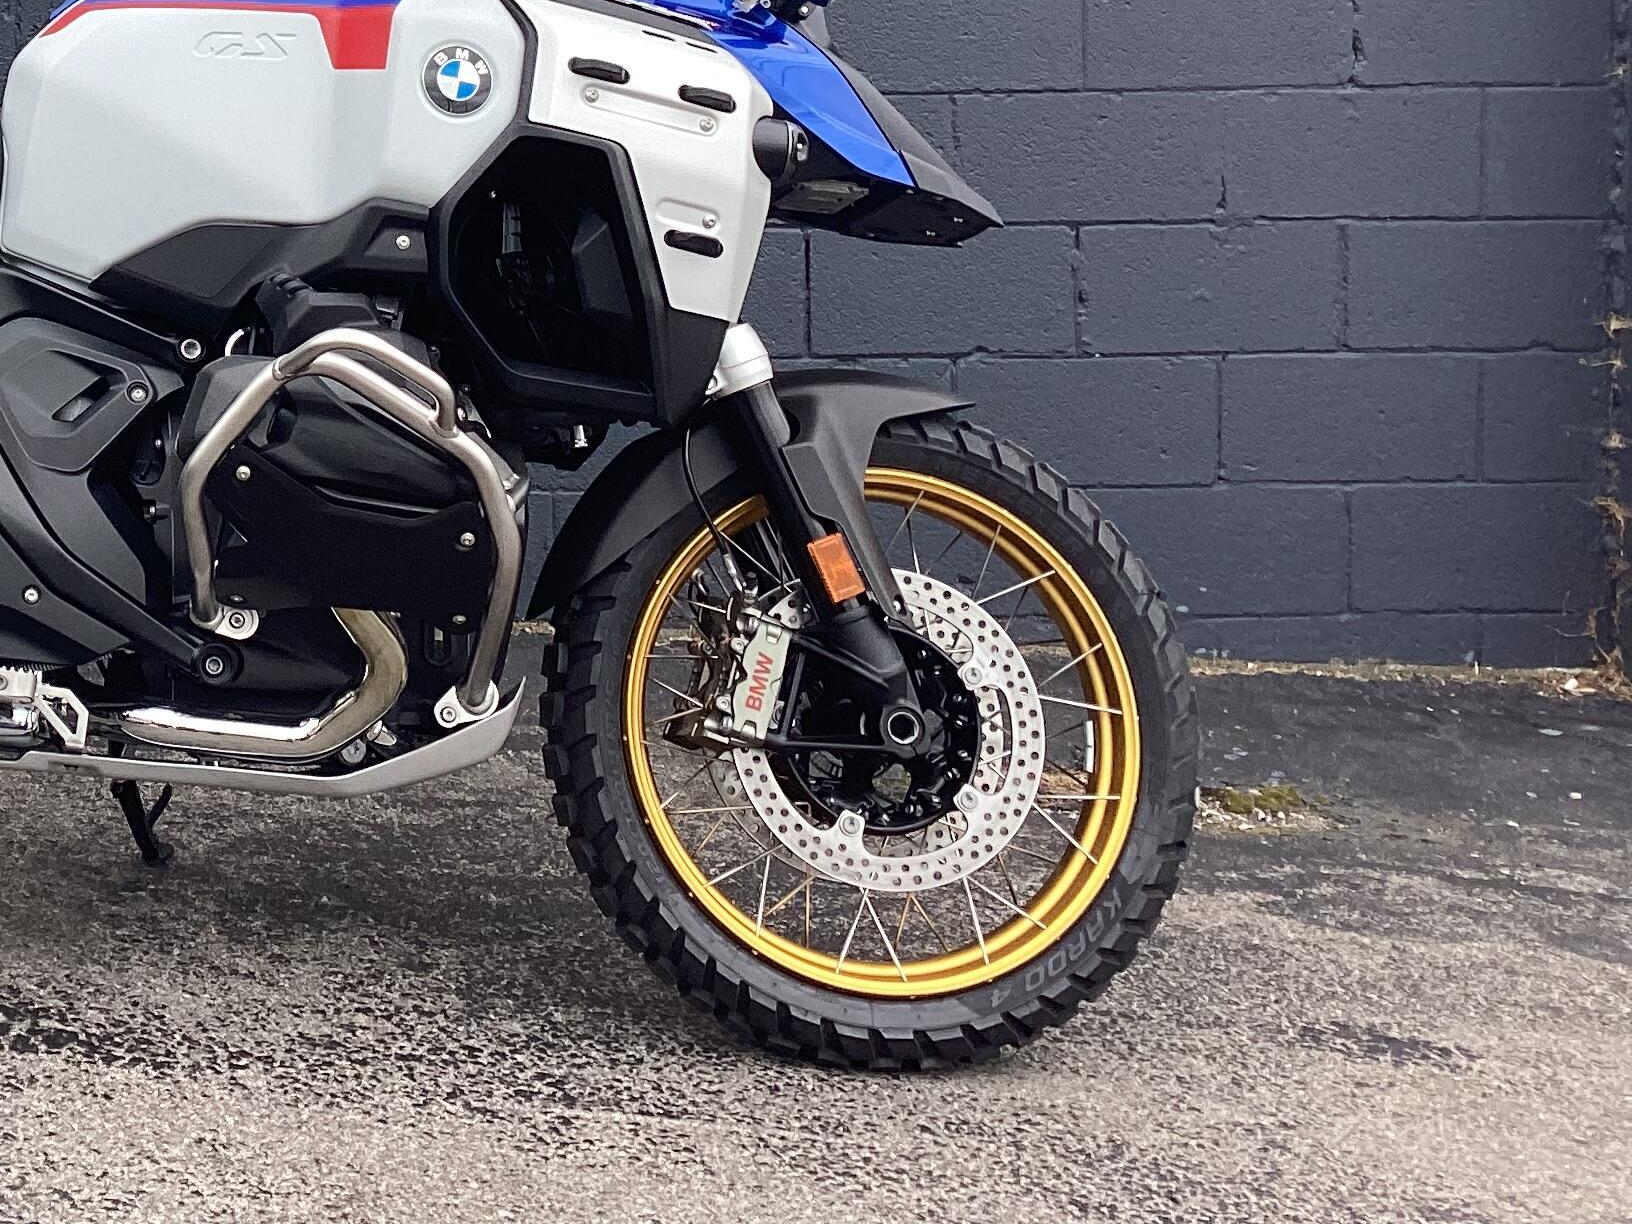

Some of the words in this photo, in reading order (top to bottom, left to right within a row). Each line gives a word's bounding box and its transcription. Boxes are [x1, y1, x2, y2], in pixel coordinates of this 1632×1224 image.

[433, 47, 489, 75] BMW
[745, 652, 774, 712] BMW
[1024, 886, 1122, 992] KAROO
[990, 986, 1011, 1008] 4
